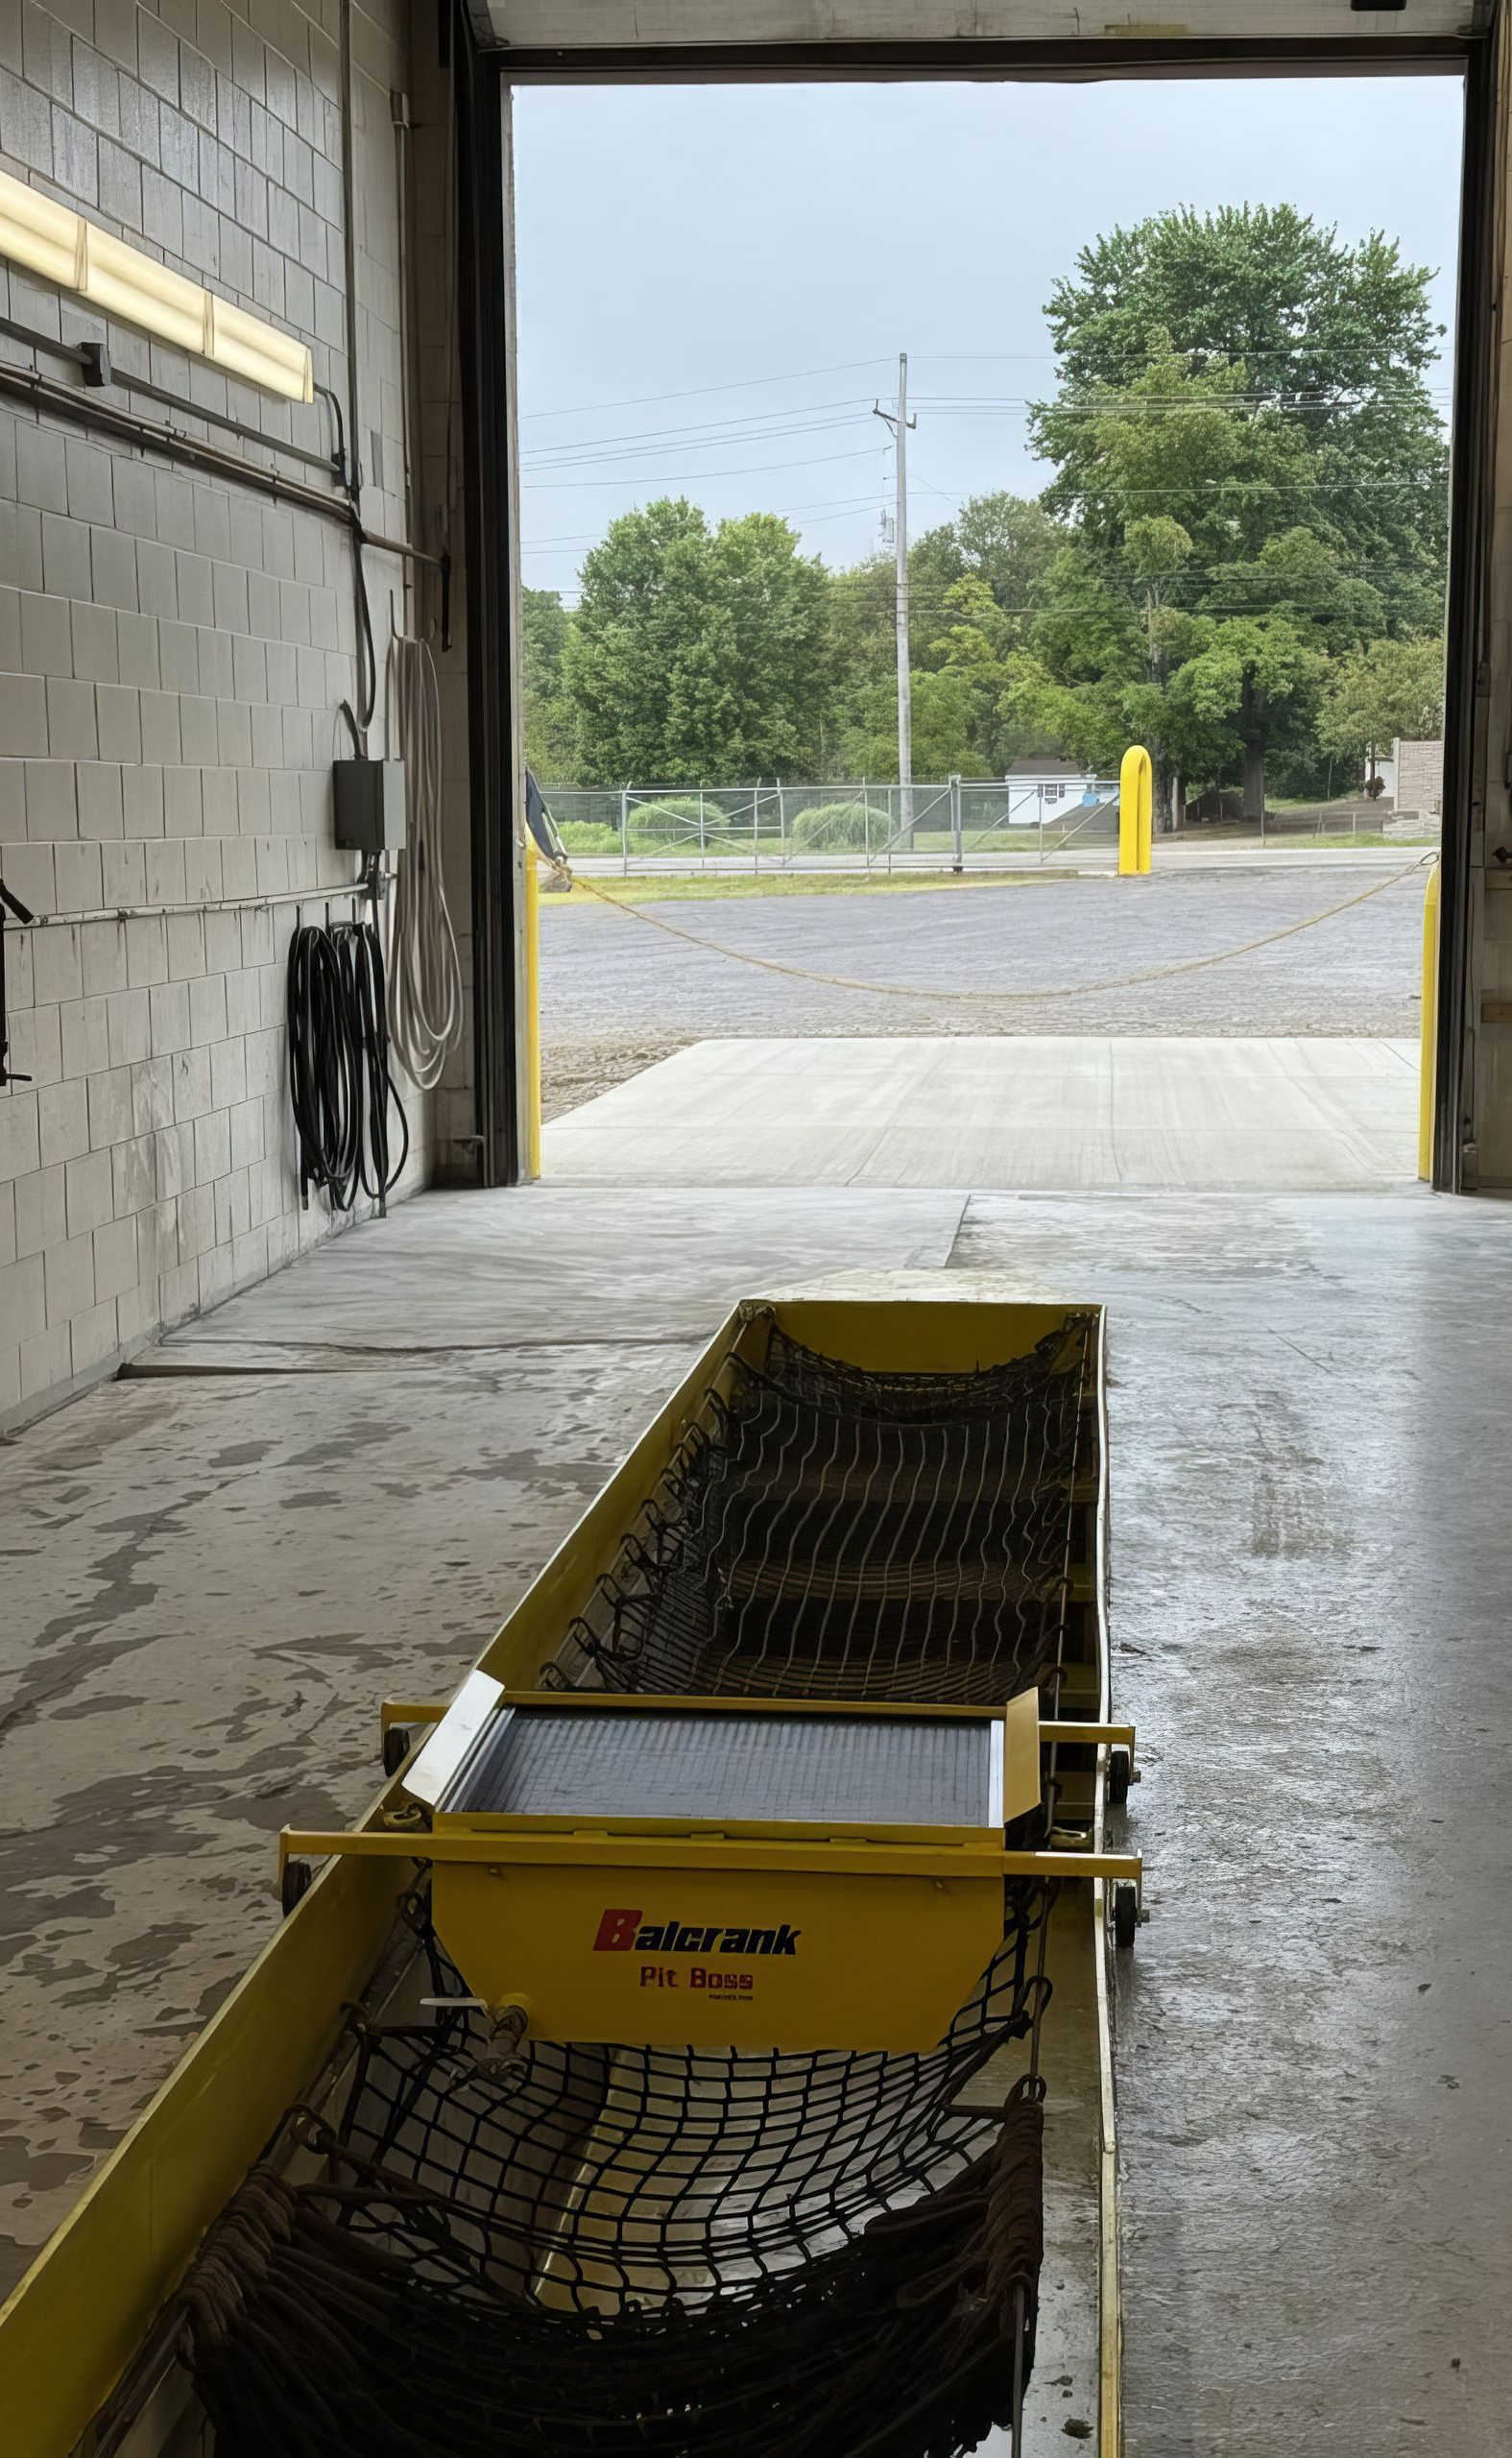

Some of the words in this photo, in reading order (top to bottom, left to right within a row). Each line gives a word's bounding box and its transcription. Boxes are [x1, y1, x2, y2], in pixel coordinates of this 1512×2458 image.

[593, 1909, 801, 1955] Balcrank
[639, 1966, 679, 1988] Pit
[689, 1967, 754, 1990] Boss
